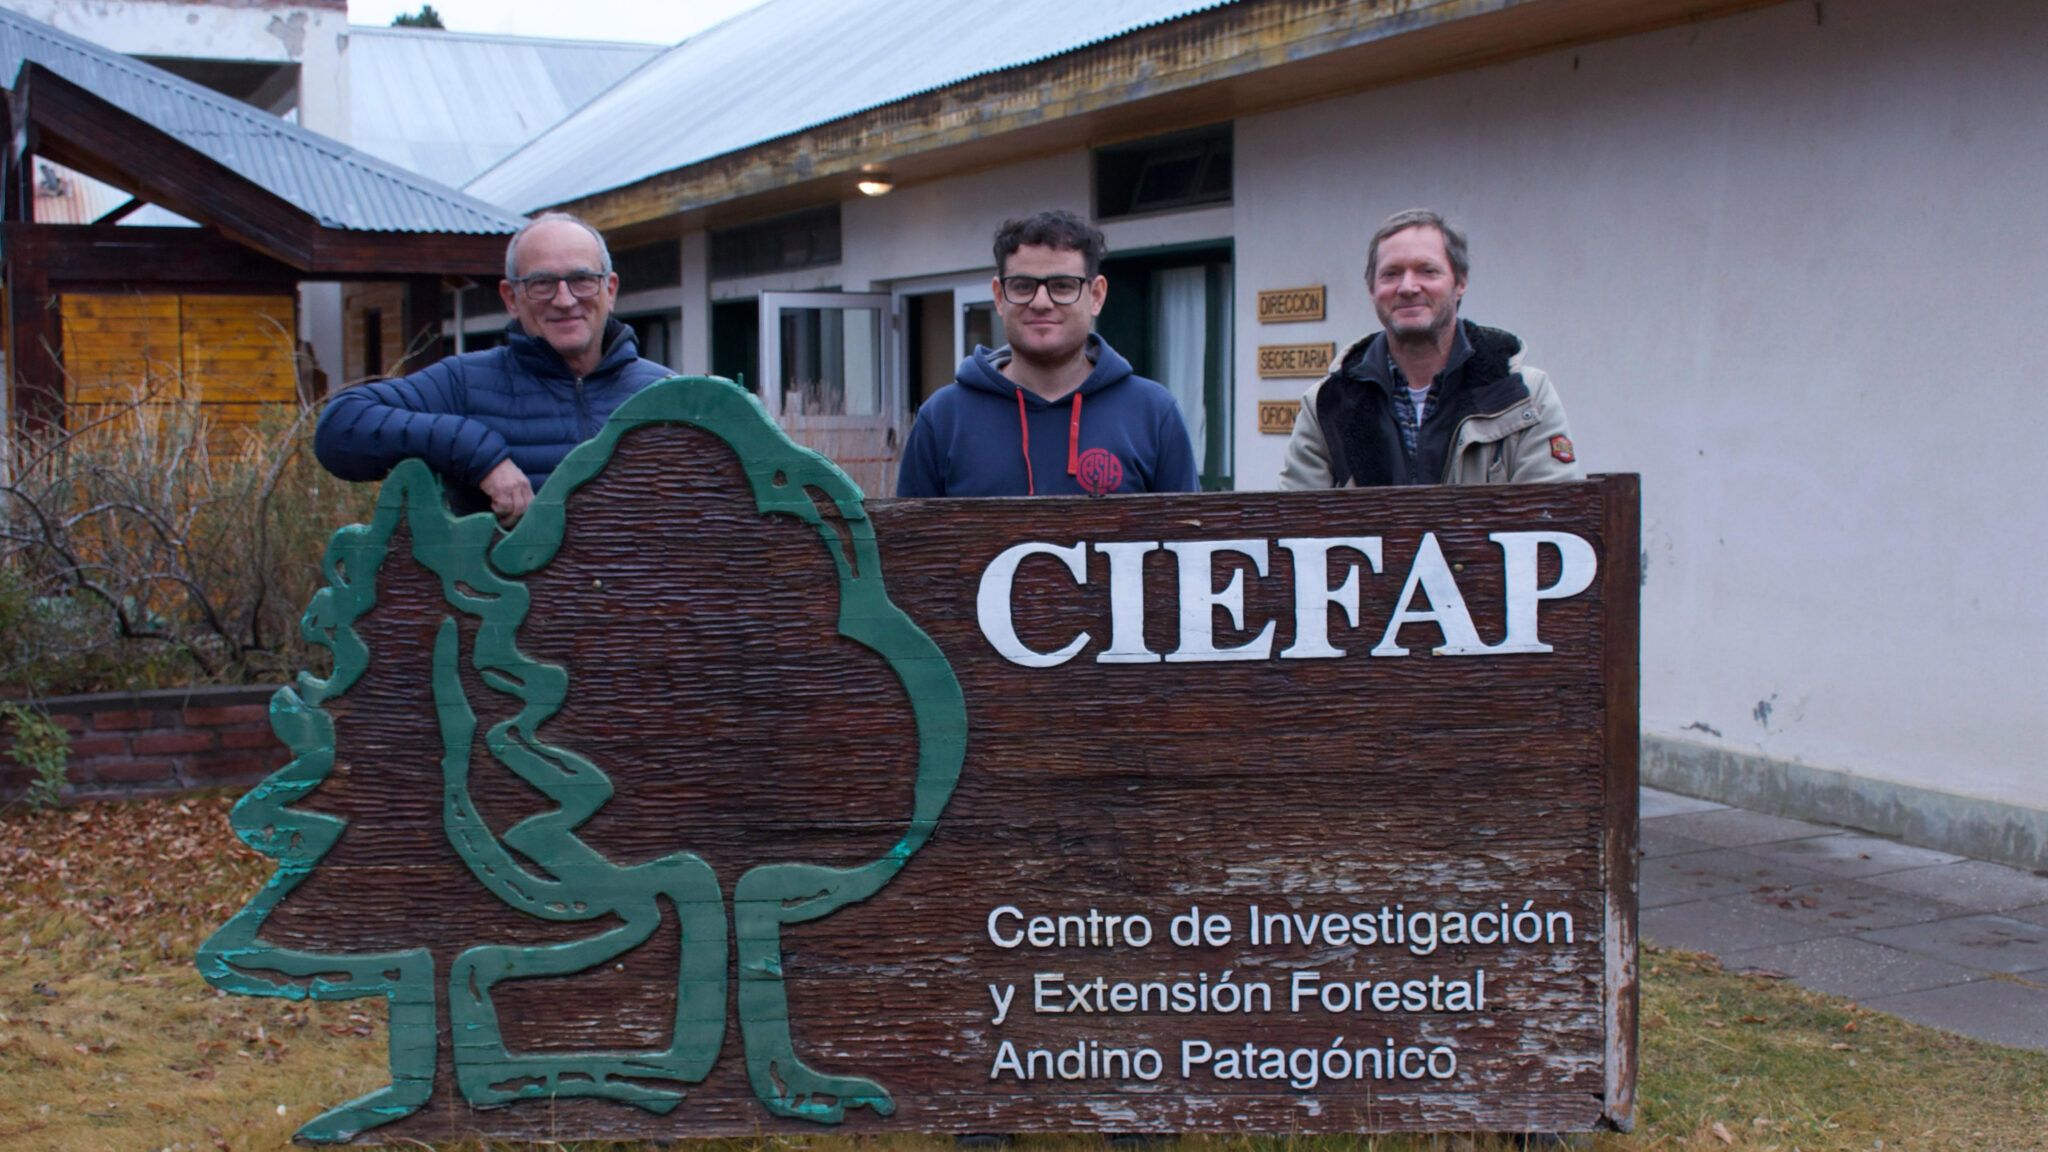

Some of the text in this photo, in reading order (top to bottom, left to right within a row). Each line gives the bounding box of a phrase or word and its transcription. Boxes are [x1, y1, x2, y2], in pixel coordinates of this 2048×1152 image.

[1260, 293, 1320, 315] DIRECCION
[1260, 349, 1329, 370] SECRETARIA
[1261, 406, 1300, 425] OFICIN
[976, 531, 1598, 668] CIEFAP
[987, 900, 1574, 955] Centro de Investigación
[988, 969, 1485, 1025] y Extensión Forestal
[990, 1036, 1458, 1090] Andino Patagónico
